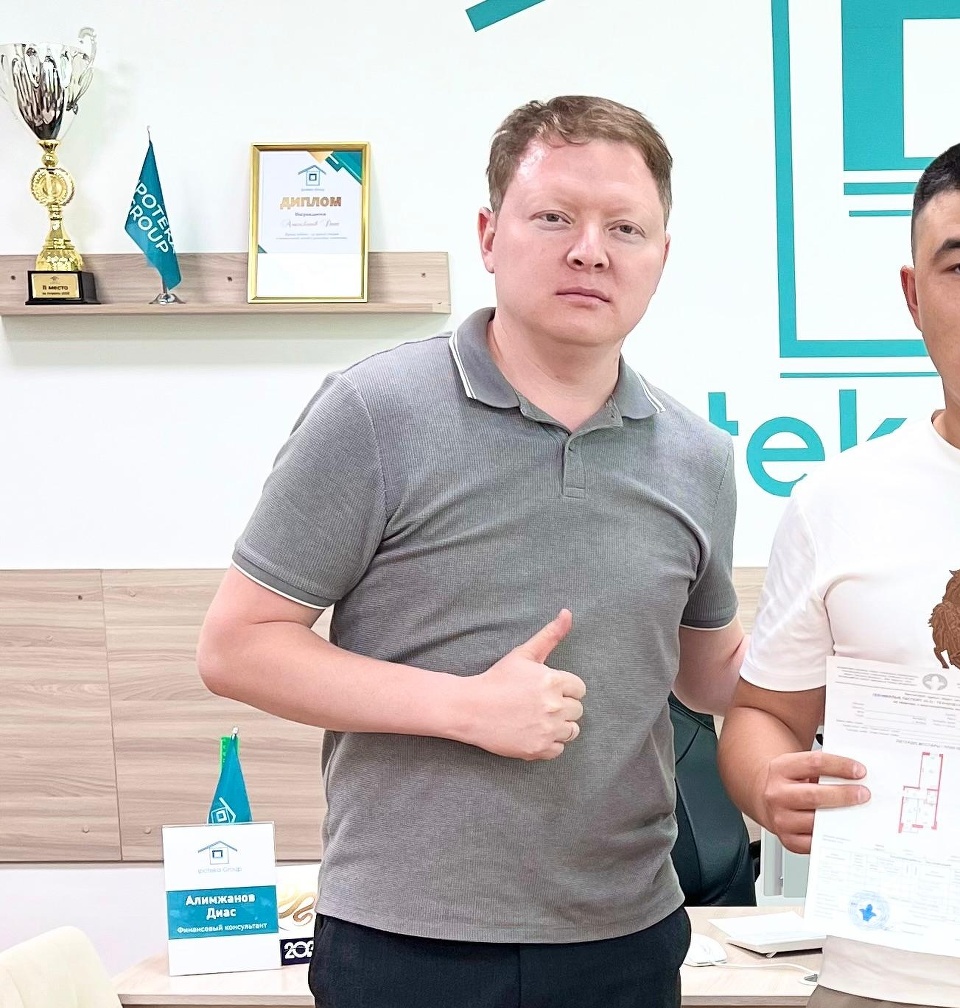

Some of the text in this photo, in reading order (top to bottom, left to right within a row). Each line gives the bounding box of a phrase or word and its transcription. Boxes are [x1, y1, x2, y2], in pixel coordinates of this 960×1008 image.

[280, 196, 342, 210] ДИПЛОМ
[130, 199, 169, 253] ROUP
[185, 893, 256, 906] Алимжанов
[206, 907, 237, 921] Диас
[177, 922, 268, 934] Финансовый консультант
